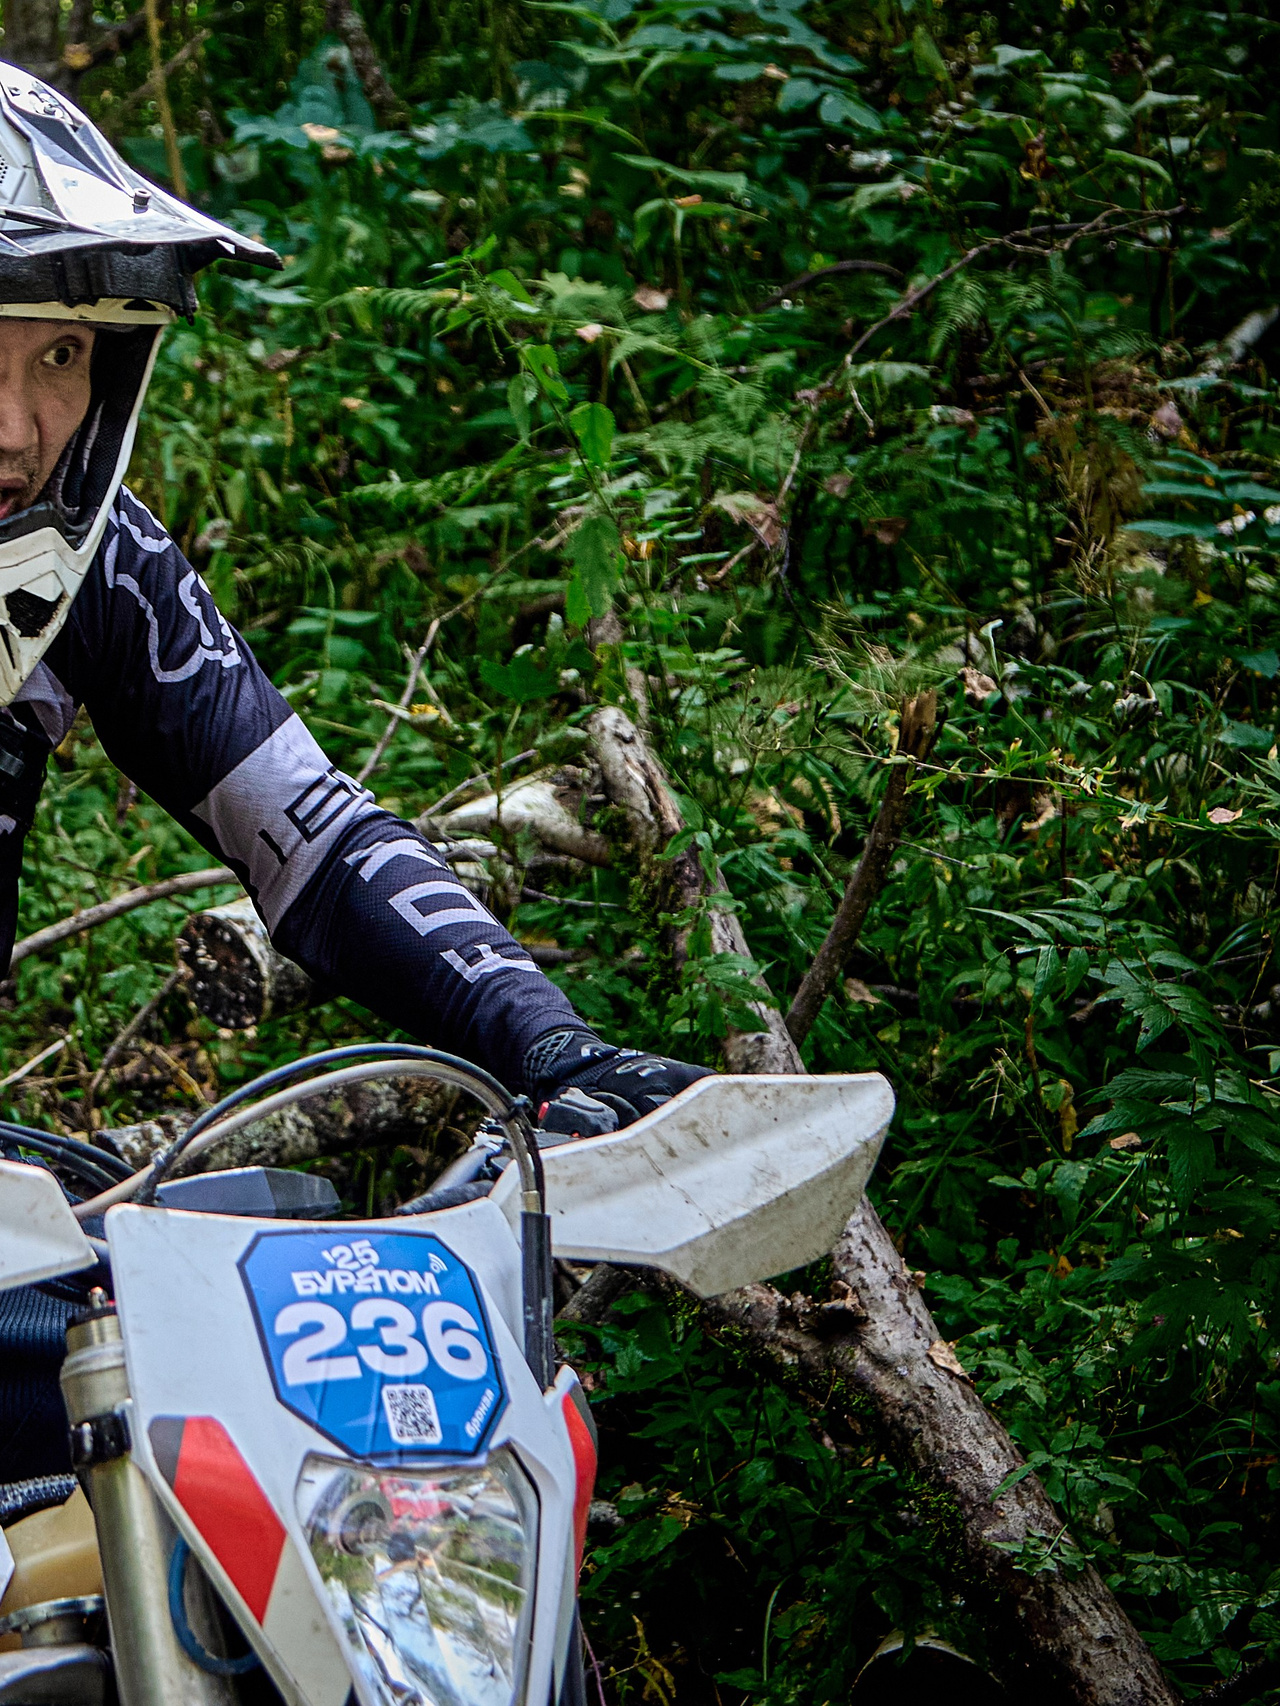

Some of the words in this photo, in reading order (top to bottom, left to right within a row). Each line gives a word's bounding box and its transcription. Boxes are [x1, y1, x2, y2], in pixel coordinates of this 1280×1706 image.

[343, 837, 544, 984] FOX
[321, 1239, 380, 1270] '25
[275, 1298, 488, 1387] 236
